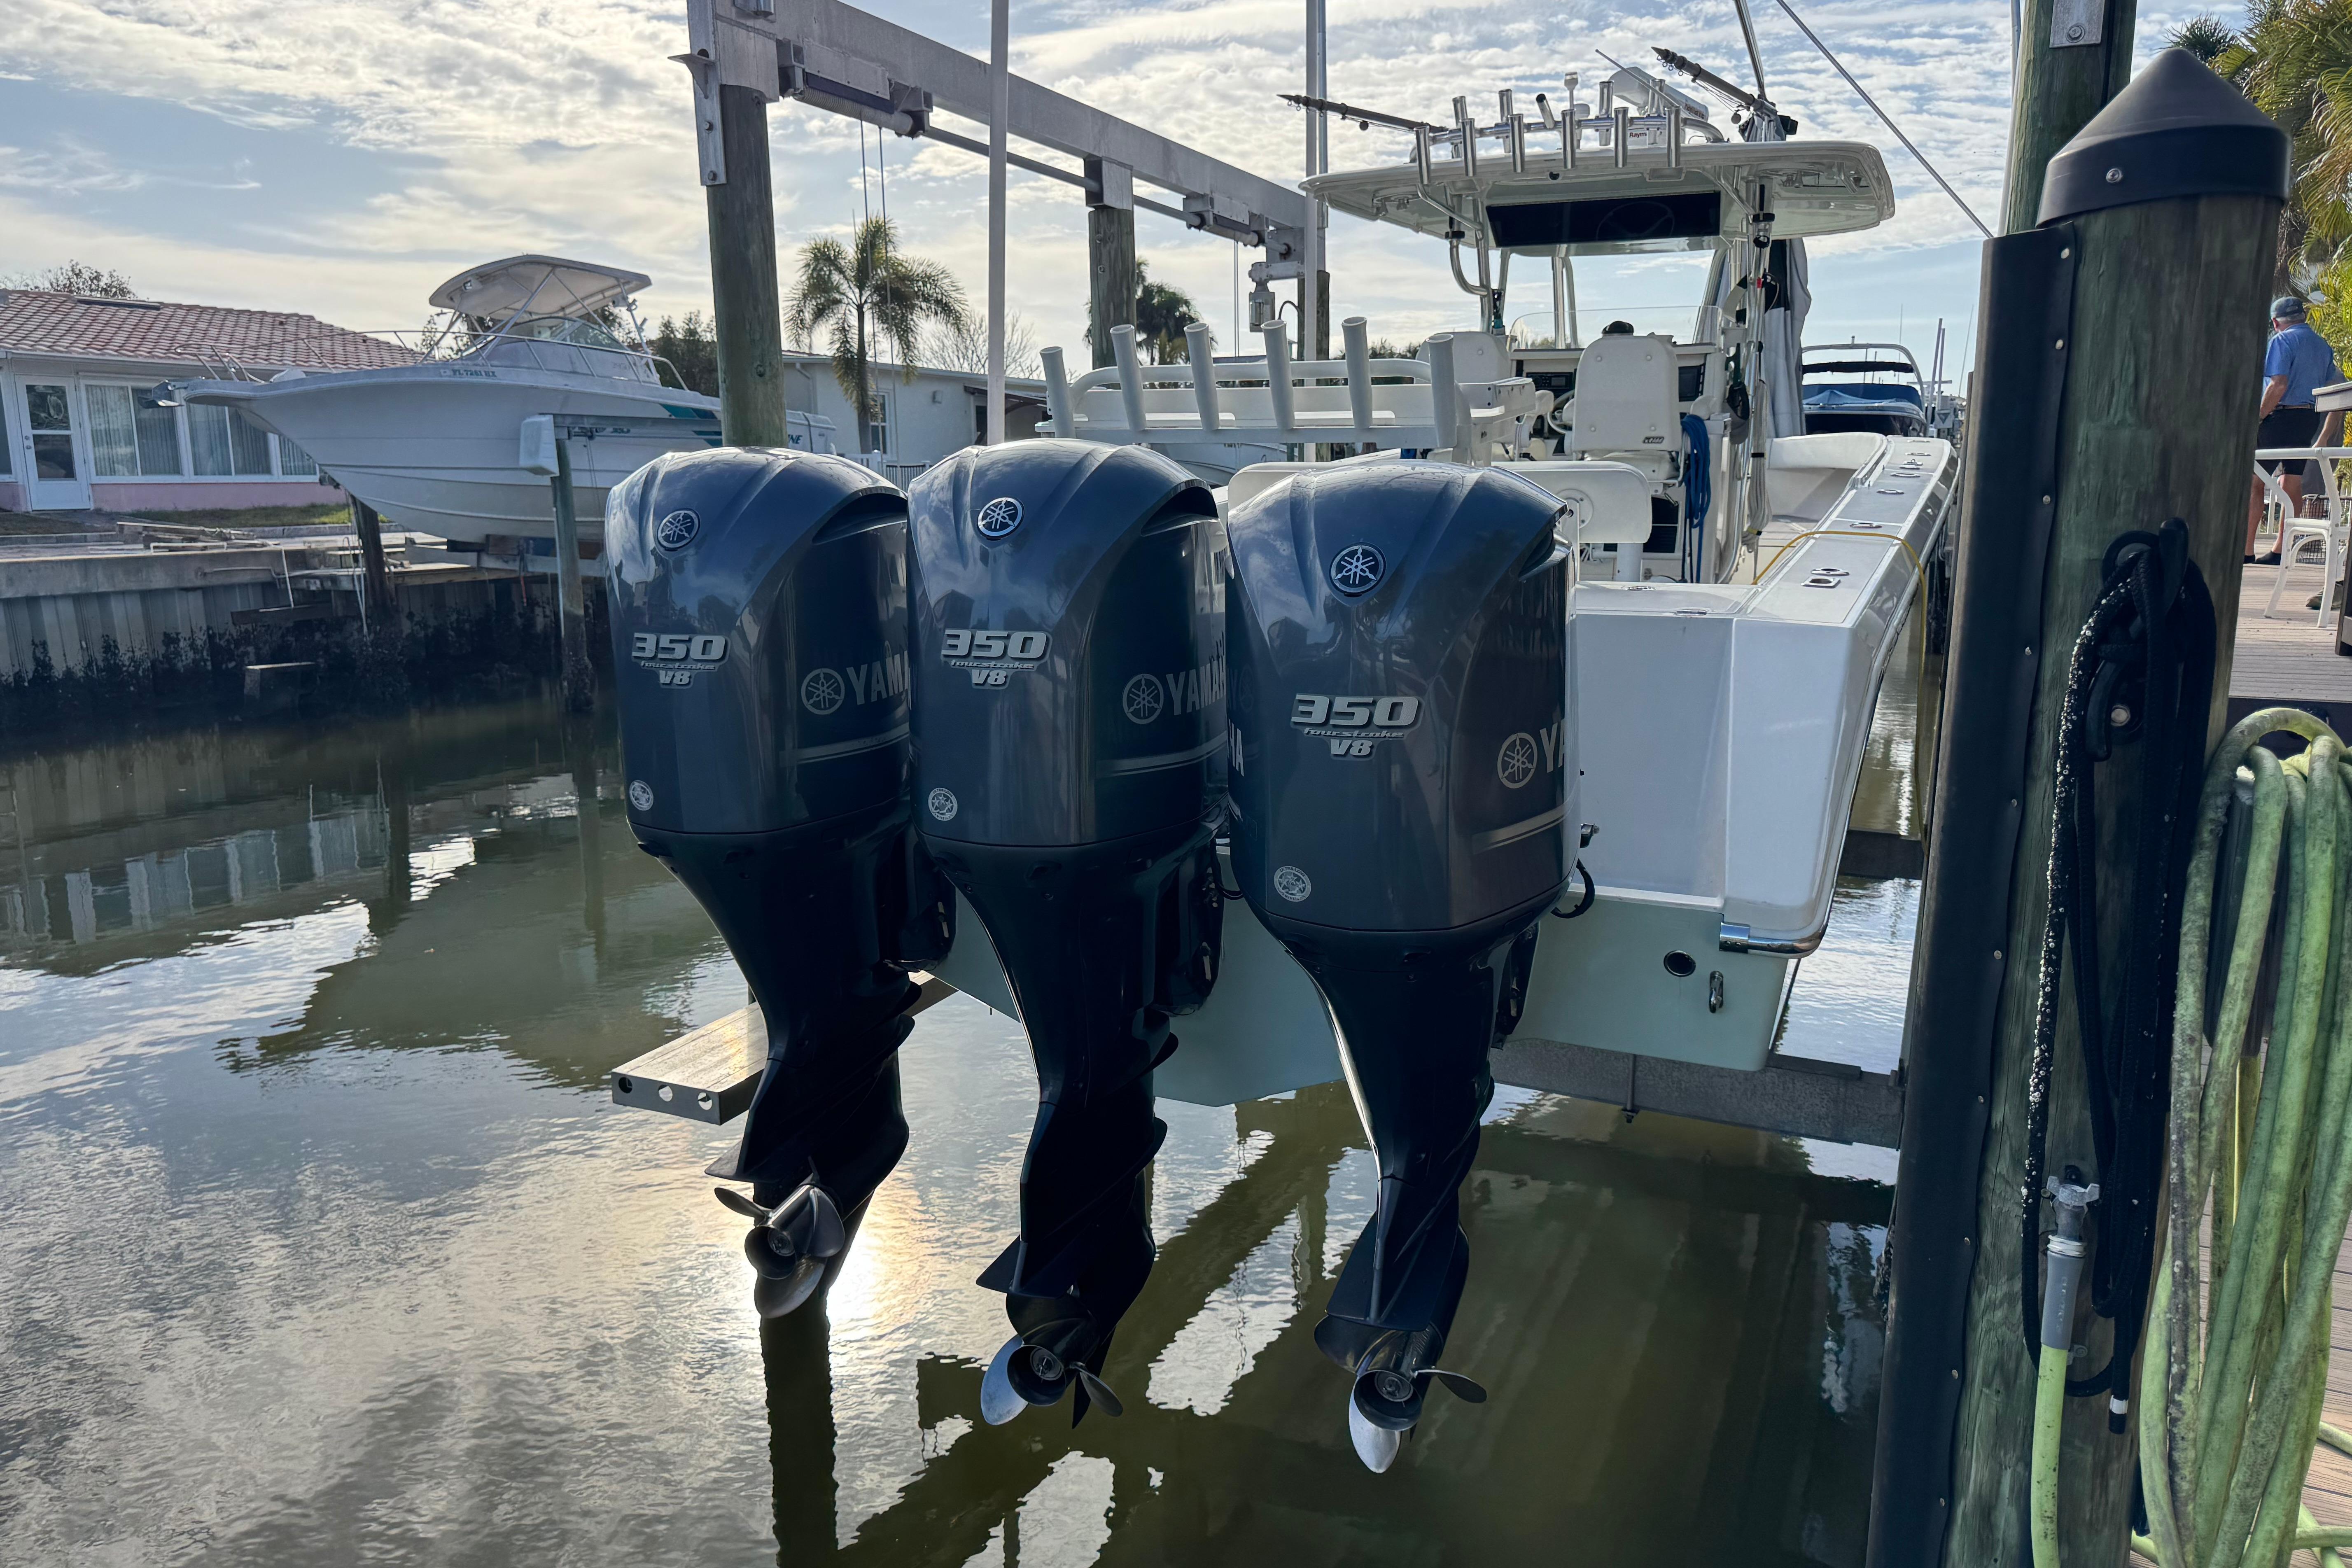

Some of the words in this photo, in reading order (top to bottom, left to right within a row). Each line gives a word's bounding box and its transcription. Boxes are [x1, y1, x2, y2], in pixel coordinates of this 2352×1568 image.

[632, 632, 726, 660] 350
[941, 629, 1047, 658] 350
[659, 670, 691, 684] V8
[972, 669, 1007, 685] V8
[1291, 694, 1419, 726] 350
[1304, 727, 1404, 737] fourstroke
[1330, 739, 1373, 756] V8
